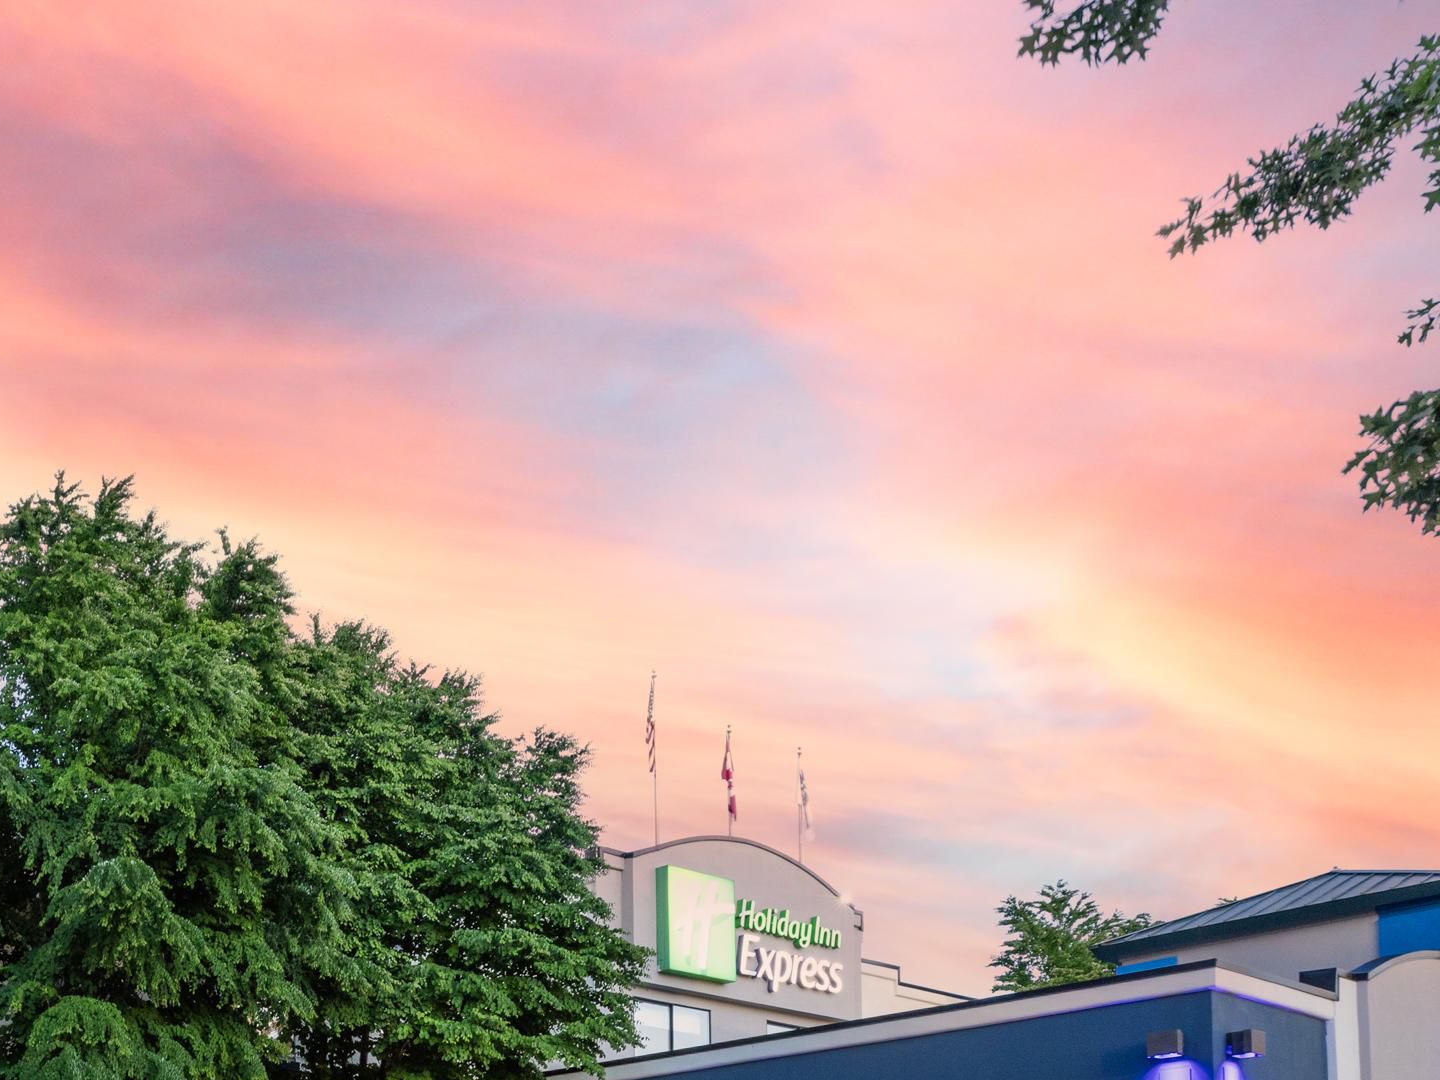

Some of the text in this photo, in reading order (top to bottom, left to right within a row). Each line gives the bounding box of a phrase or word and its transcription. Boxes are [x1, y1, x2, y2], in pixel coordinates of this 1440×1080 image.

[737, 898, 842, 948] Holiday Inn
[738, 934, 844, 993] Express
